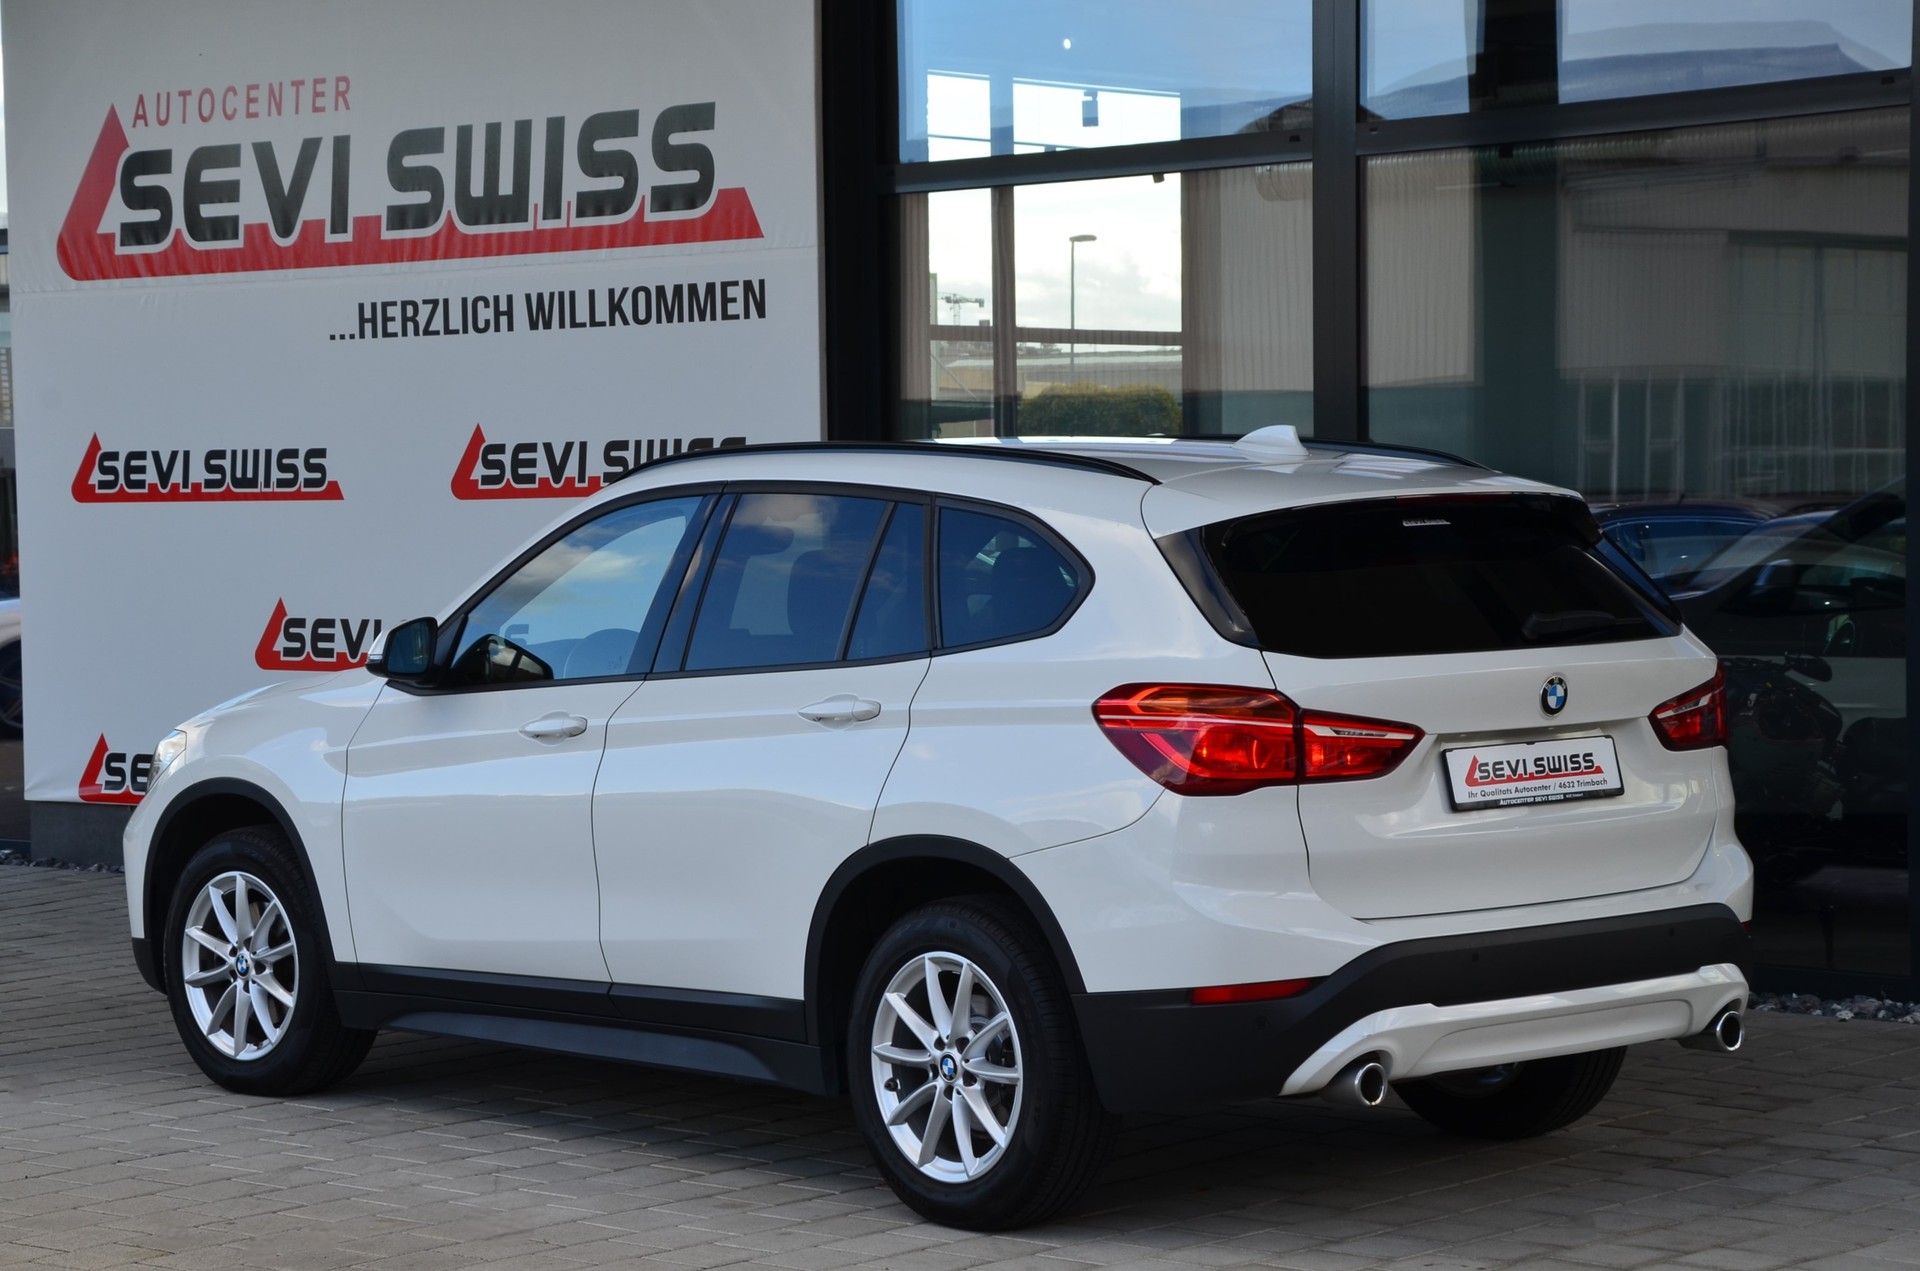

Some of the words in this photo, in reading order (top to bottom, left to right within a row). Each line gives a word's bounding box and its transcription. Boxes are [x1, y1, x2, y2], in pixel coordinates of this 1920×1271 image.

[132, 76, 352, 128] AUTOCENTER
[120, 134, 351, 248] SEVI
[385, 101, 717, 232] SWISS
[524, 279, 767, 332] WILLKOMMEN
[97, 450, 191, 491] SEVI
[203, 447, 328, 490] SWISS
[480, 441, 588, 486] SEVI
[1467, 790, 1479, 799] Ihr
[1514, 782, 1552, 794] Autocenter
[1558, 780, 1576, 790] 4632
[1576, 777, 1608, 788] Trimbach
[1478, 758, 1527, 780] SEVI
[1534, 752, 1595, 775] SWISS
